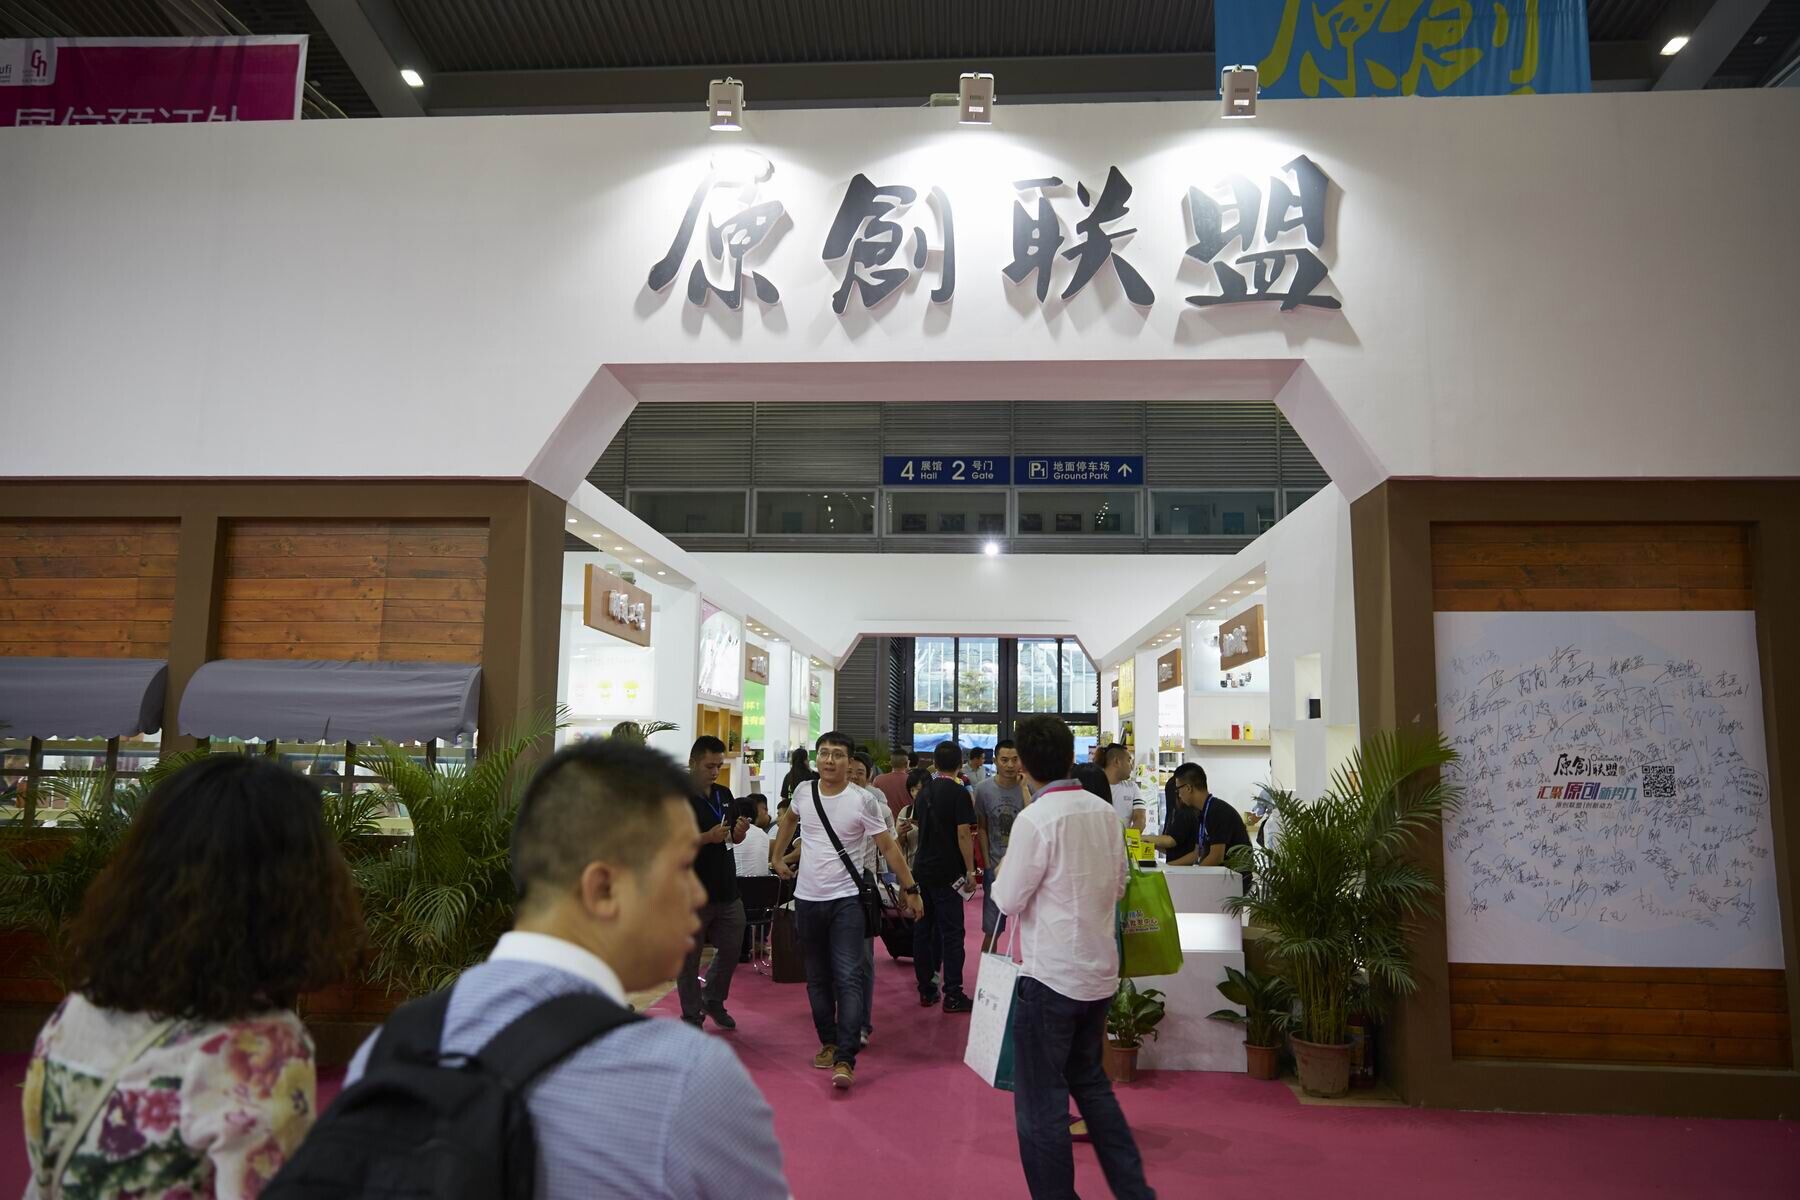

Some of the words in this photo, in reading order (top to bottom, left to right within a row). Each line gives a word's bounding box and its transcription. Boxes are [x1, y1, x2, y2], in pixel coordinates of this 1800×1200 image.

[900, 461, 915, 481] 4
[920, 460, 943, 471] 展馆
[951, 460, 966, 481] 2
[971, 460, 993, 471] 号门
[1053, 461, 1110, 472] 地面停车场
[920, 472, 938, 480] Hall
[971, 472, 994, 480] Gate
[1053, 472, 1087, 480] Ground
[1089, 472, 1109, 480] Park
